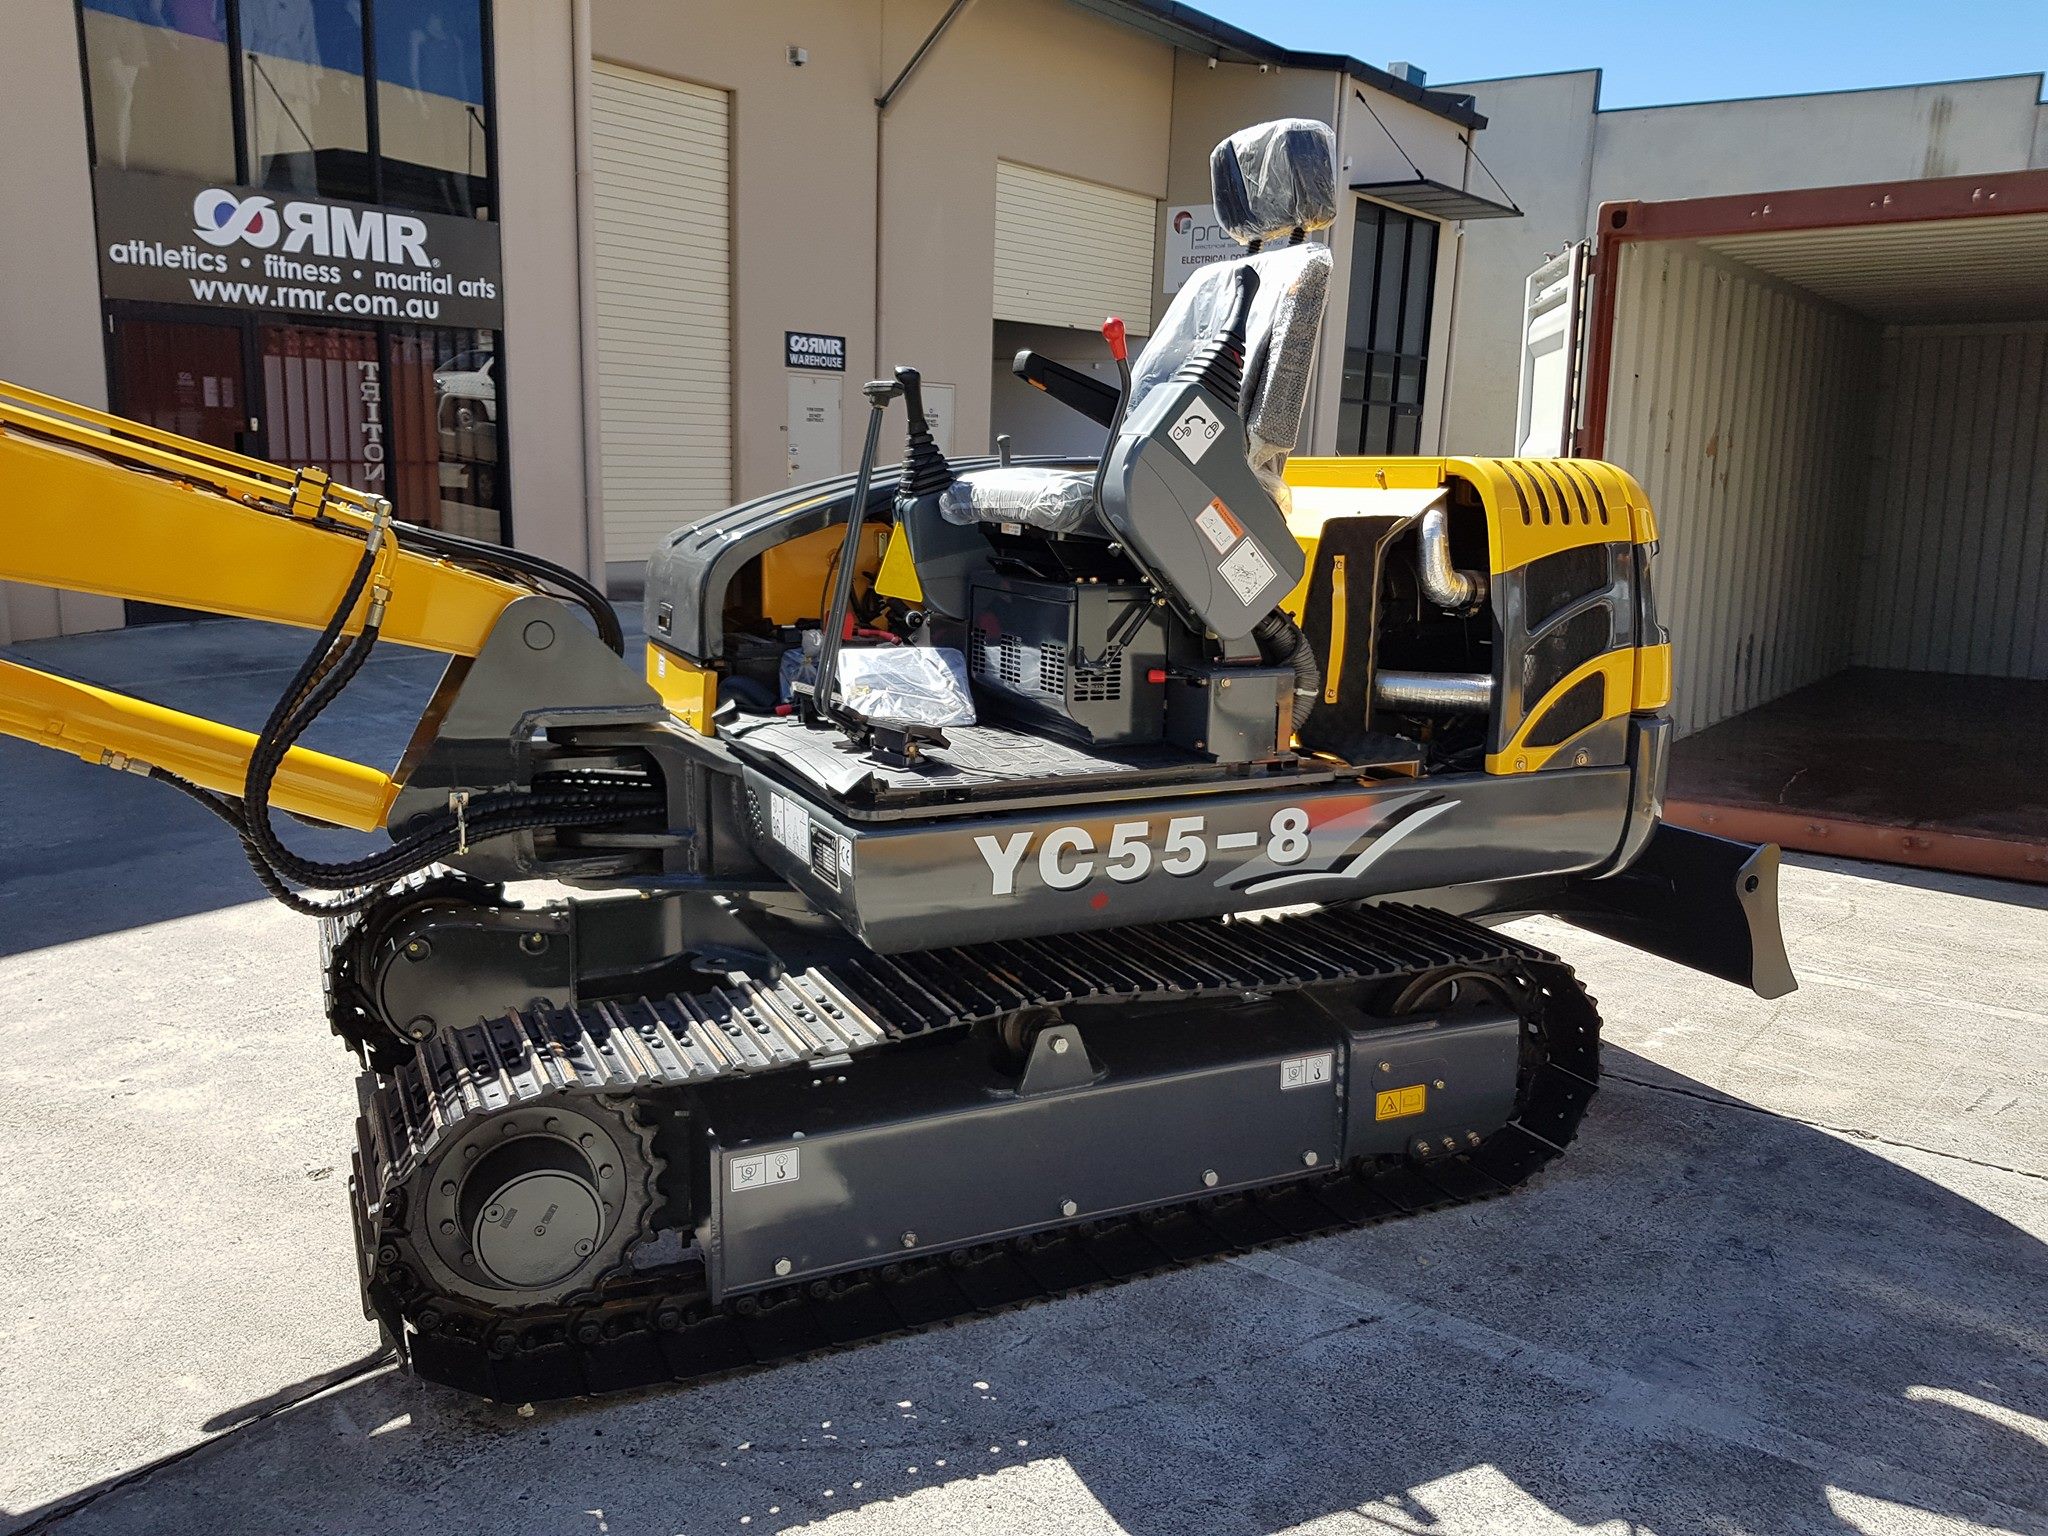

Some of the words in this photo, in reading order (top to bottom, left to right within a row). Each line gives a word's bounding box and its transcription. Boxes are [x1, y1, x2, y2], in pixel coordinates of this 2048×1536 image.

[109, 239, 228, 273] athletics
[263, 253, 342, 284] fitness
[375, 271, 453, 295] martial
[458, 277, 496, 299] arts
[1181, 254, 1227, 265] ELECTRICAL
[188, 278, 440, 320] www.rmr.com.au
[789, 353, 842, 368] WAREHOUSE
[973, 807, 1311, 896] YC55-8
